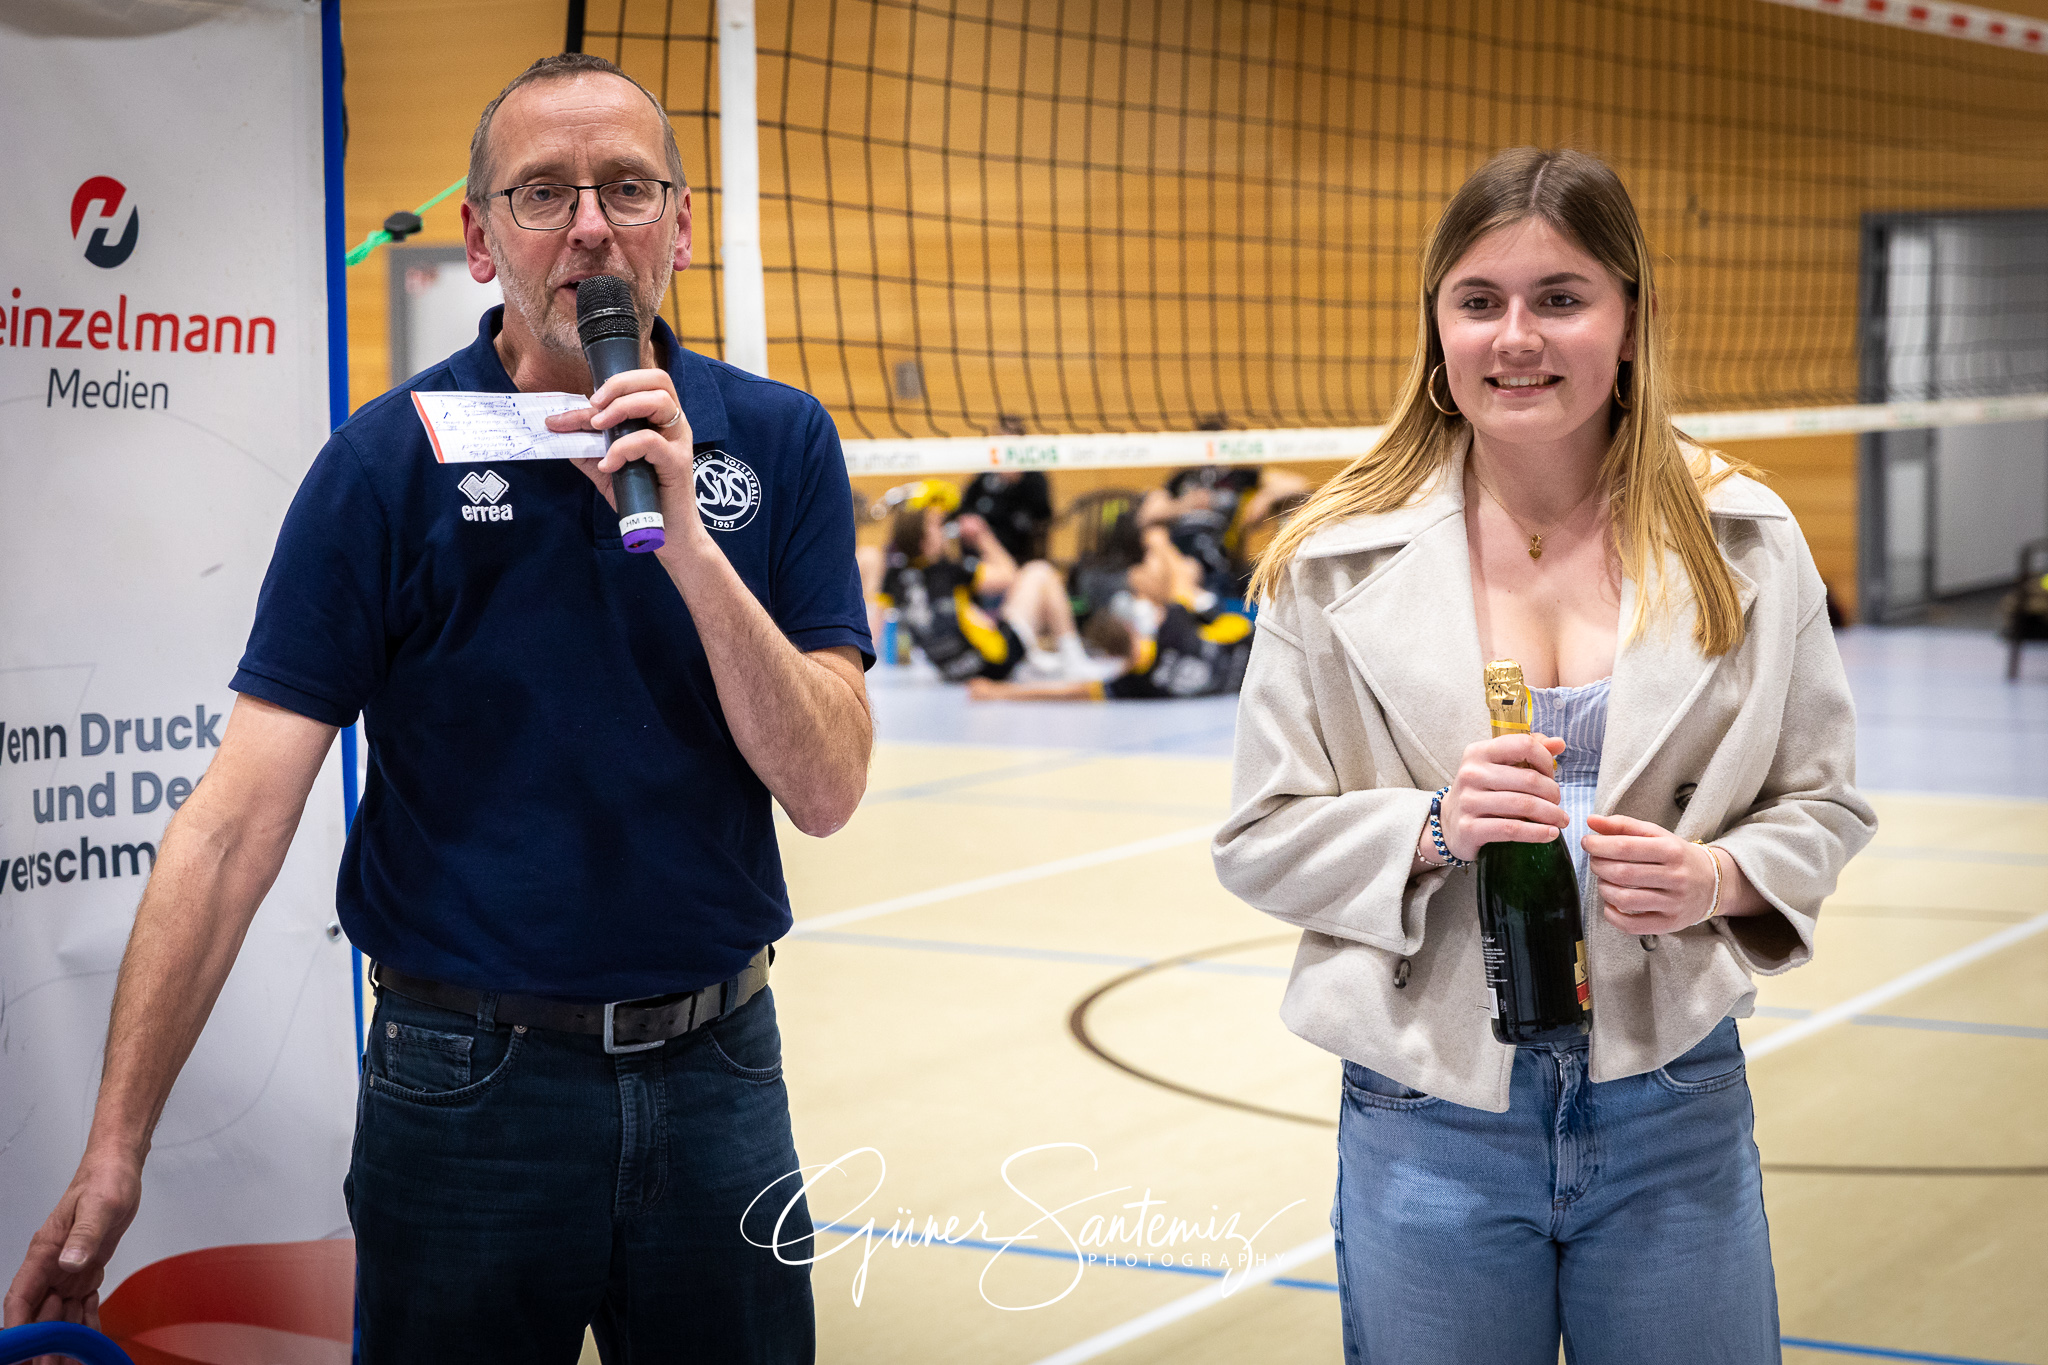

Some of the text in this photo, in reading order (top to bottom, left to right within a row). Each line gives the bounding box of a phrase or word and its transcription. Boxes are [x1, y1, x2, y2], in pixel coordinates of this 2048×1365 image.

[0, 287, 276, 354] inzelmann
[46, 368, 169, 410] Medien
[724, 456, 758, 506] VOLLEYBALL
[713, 519, 735, 529] 1967
[0, 704, 222, 766] enn Druck
[33, 771, 204, 823] und De
